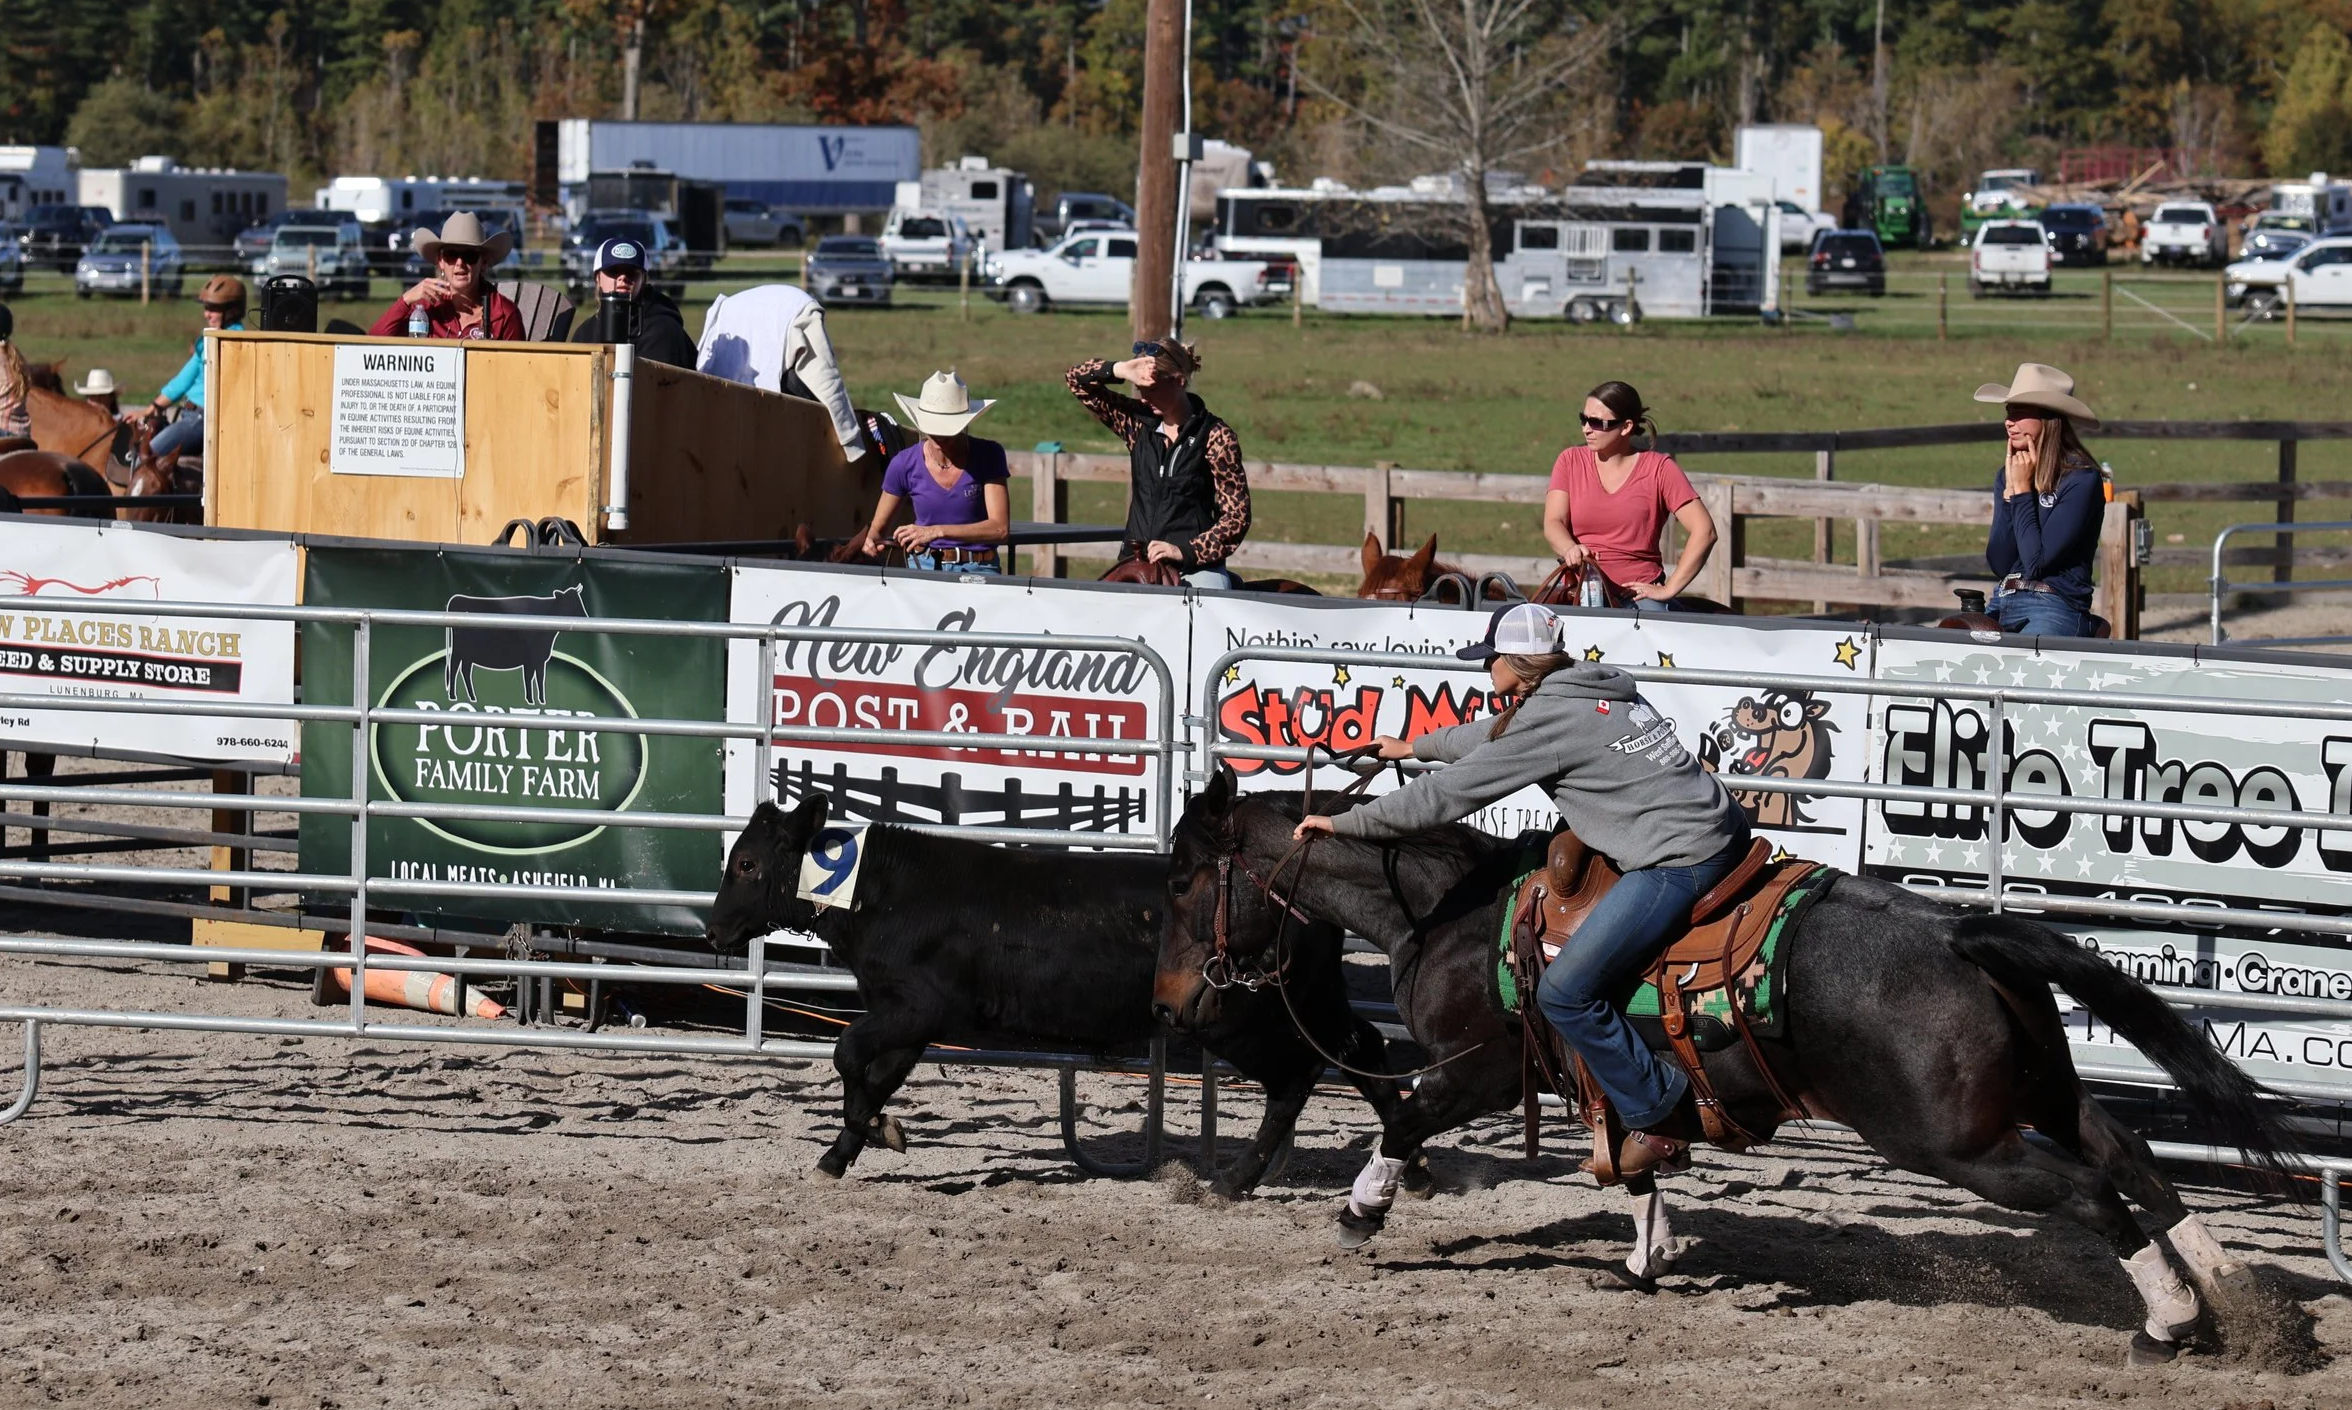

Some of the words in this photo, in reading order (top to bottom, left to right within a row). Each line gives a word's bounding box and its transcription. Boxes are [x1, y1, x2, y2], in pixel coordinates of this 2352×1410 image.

[363, 353, 435, 373] WARNING
[341, 377, 361, 386] UNDER
[361, 379, 410, 389] MASSACHUSETTS
[426, 381, 435, 389] AN
[436, 381, 456, 390] EQUINE
[341, 389, 386, 399] PROFESSIONAL
[387, 391, 394, 399] IS
[395, 391, 408, 400] NOT
[409, 392, 431, 401] LIABLE
[432, 392, 446, 402] FOR
[447, 393, 456, 402] AN
[340, 401, 359, 410] INJURY
[369, 402, 377, 411] OR
[378, 402, 388, 411] THE
[389, 403, 407, 412] DEATH
[417, 404, 422, 412] A
[422, 404, 457, 414] PARTICIPANT
[339, 413, 346, 421] IN
[347, 413, 368, 422] EQUINE
[370, 414, 402, 424] ACTIVITIES
[403, 415, 437, 425] RESULTING
[438, 416, 456, 426] FROM
[340, 424, 350, 433] THE
[351, 425, 377, 434] INHERENT
[378, 426, 394, 435] RISKS
[395, 426, 403, 435] OF
[404, 427, 424, 436] EQUINE
[339, 436, 367, 446] PURSUANT
[368, 437, 376, 446] TO
[377, 438, 400, 447] SECTION
[410, 439, 418, 448] OF
[419, 440, 446, 449] CHAPTER
[339, 447, 347, 456] OF
[348, 448, 358, 457] THE
[359, 449, 386, 458] GENERAL
[23, 615, 133, 649] PLACES
[139, 625, 242, 658] RANCH
[771, 594, 903, 688] New
[913, 606, 1148, 715] England
[37, 653, 56, 672] &
[60, 655, 142, 678] SUPPLY
[144, 662, 211, 686] STORE
[17, 717, 30, 726] Rd
[772, 688, 918, 733] POST
[942, 702, 980, 753] &
[1000, 707, 1137, 765] RAIL
[415, 700, 601, 765] PORTER
[216, 737, 289, 749] 978-660-6244
[1626, 734, 1654, 752] HORSE
[415, 758, 514, 795] FAMILY
[522, 766, 600, 801] FARM
[1882, 697, 2074, 850] Elite
[2087, 718, 2304, 869] Tree
[809, 828, 858, 896] 9
[447, 864, 497, 884] MEATS
[2238, 952, 2352, 1000] Crane
